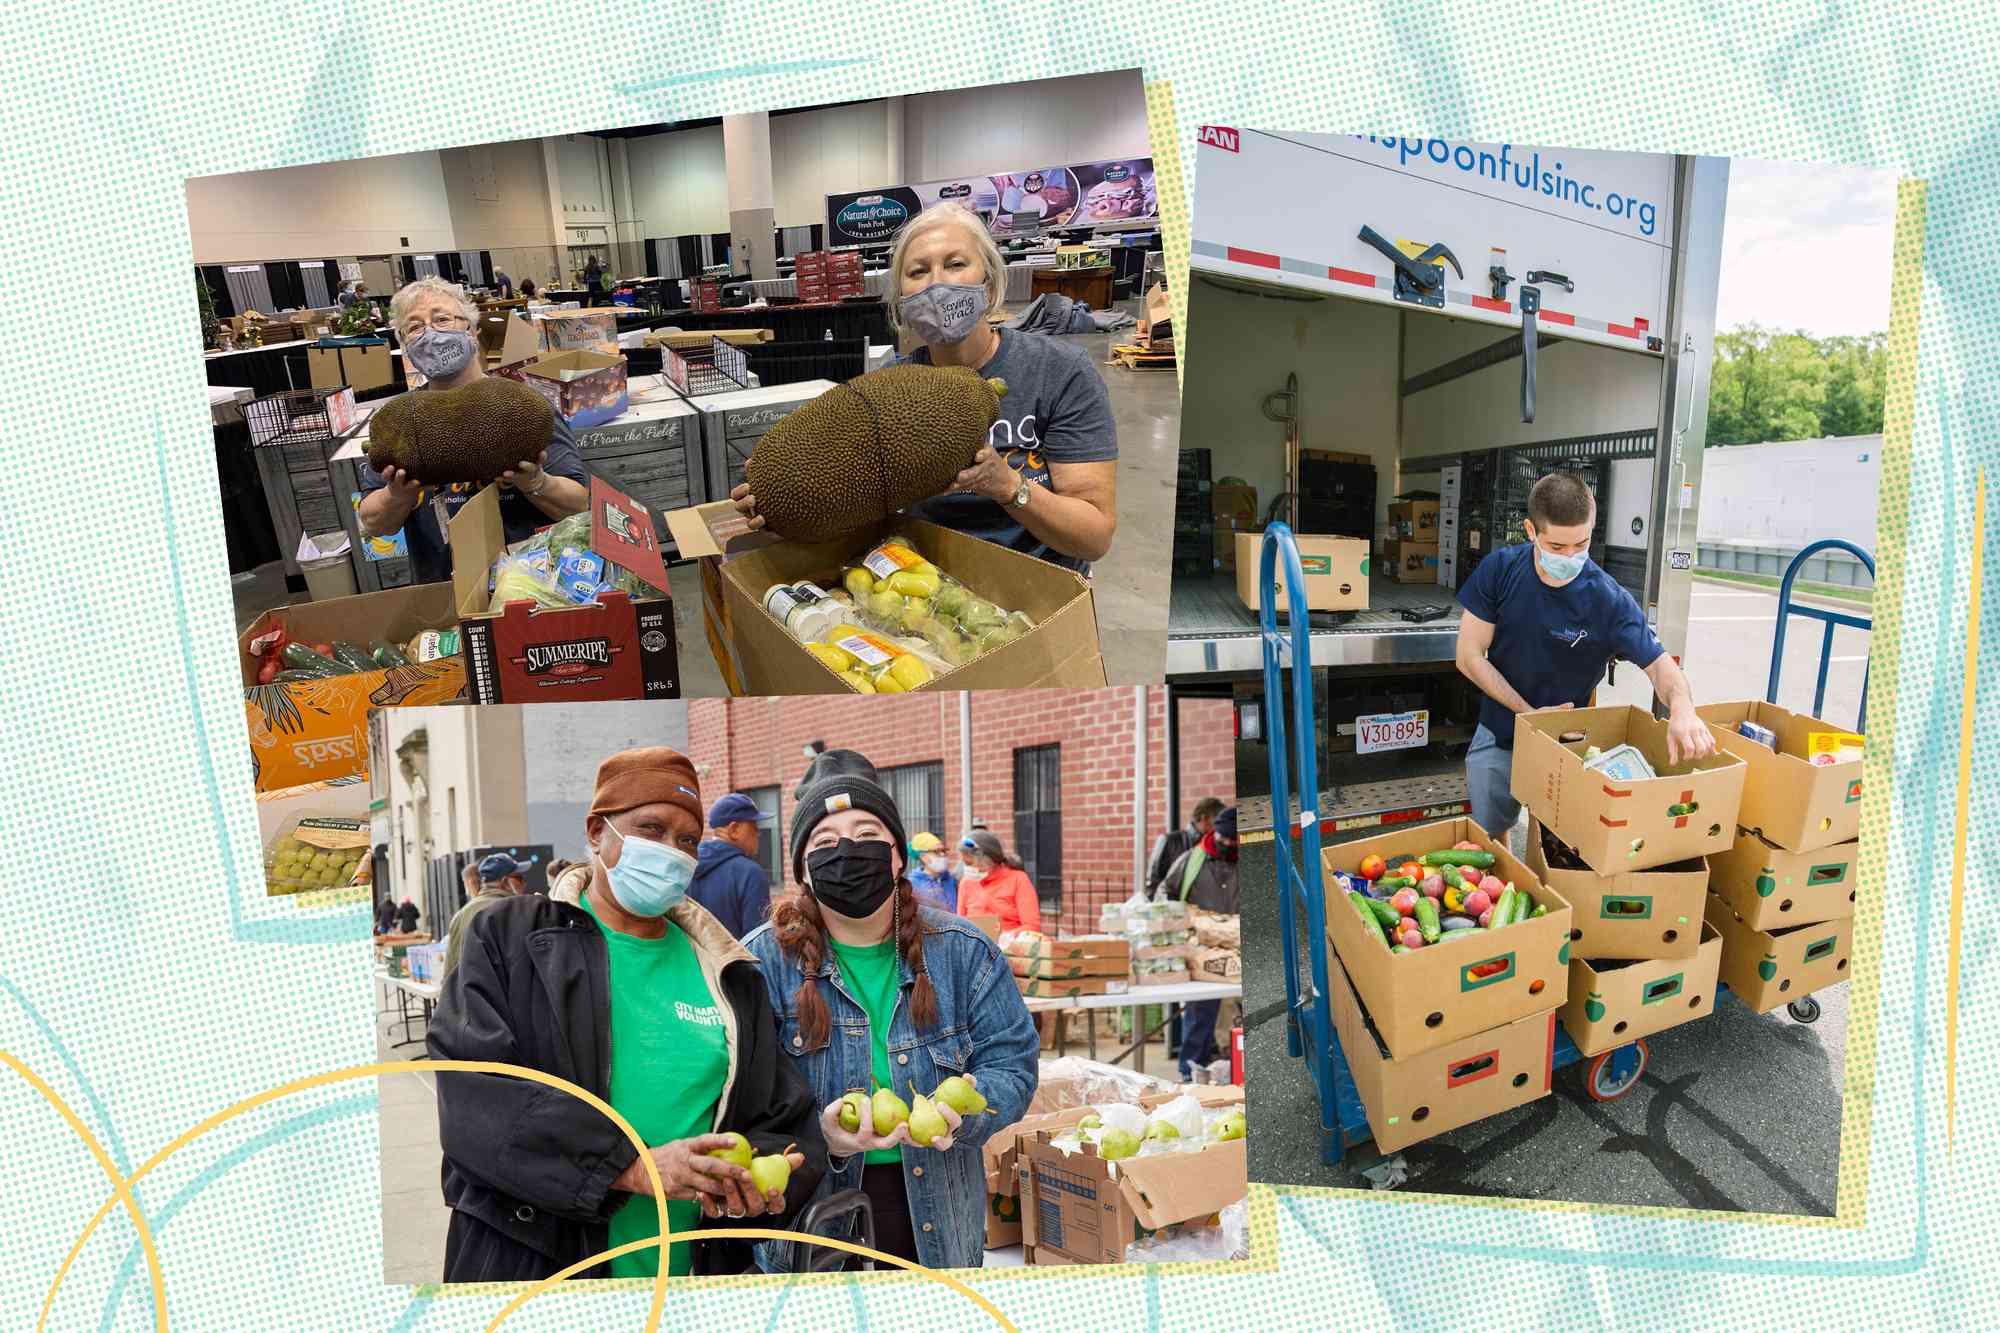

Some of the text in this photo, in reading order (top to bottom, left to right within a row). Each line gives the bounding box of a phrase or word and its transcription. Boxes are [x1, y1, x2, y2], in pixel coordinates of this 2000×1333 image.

[1356, 134, 1656, 235] spoonfulsinc.org
[844, 206, 901, 221] Natural Choice
[942, 297, 974, 312] saving
[944, 305, 975, 328] grace
[590, 432, 622, 446] From
[624, 428, 642, 442] the
[990, 415, 1040, 449] ng
[527, 641, 608, 672] SUMMERIPE
[293, 738, 355, 769] ssa's
[674, 1001, 721, 1016] CITY HARV
[675, 1009, 722, 1026] VOLUNTE
